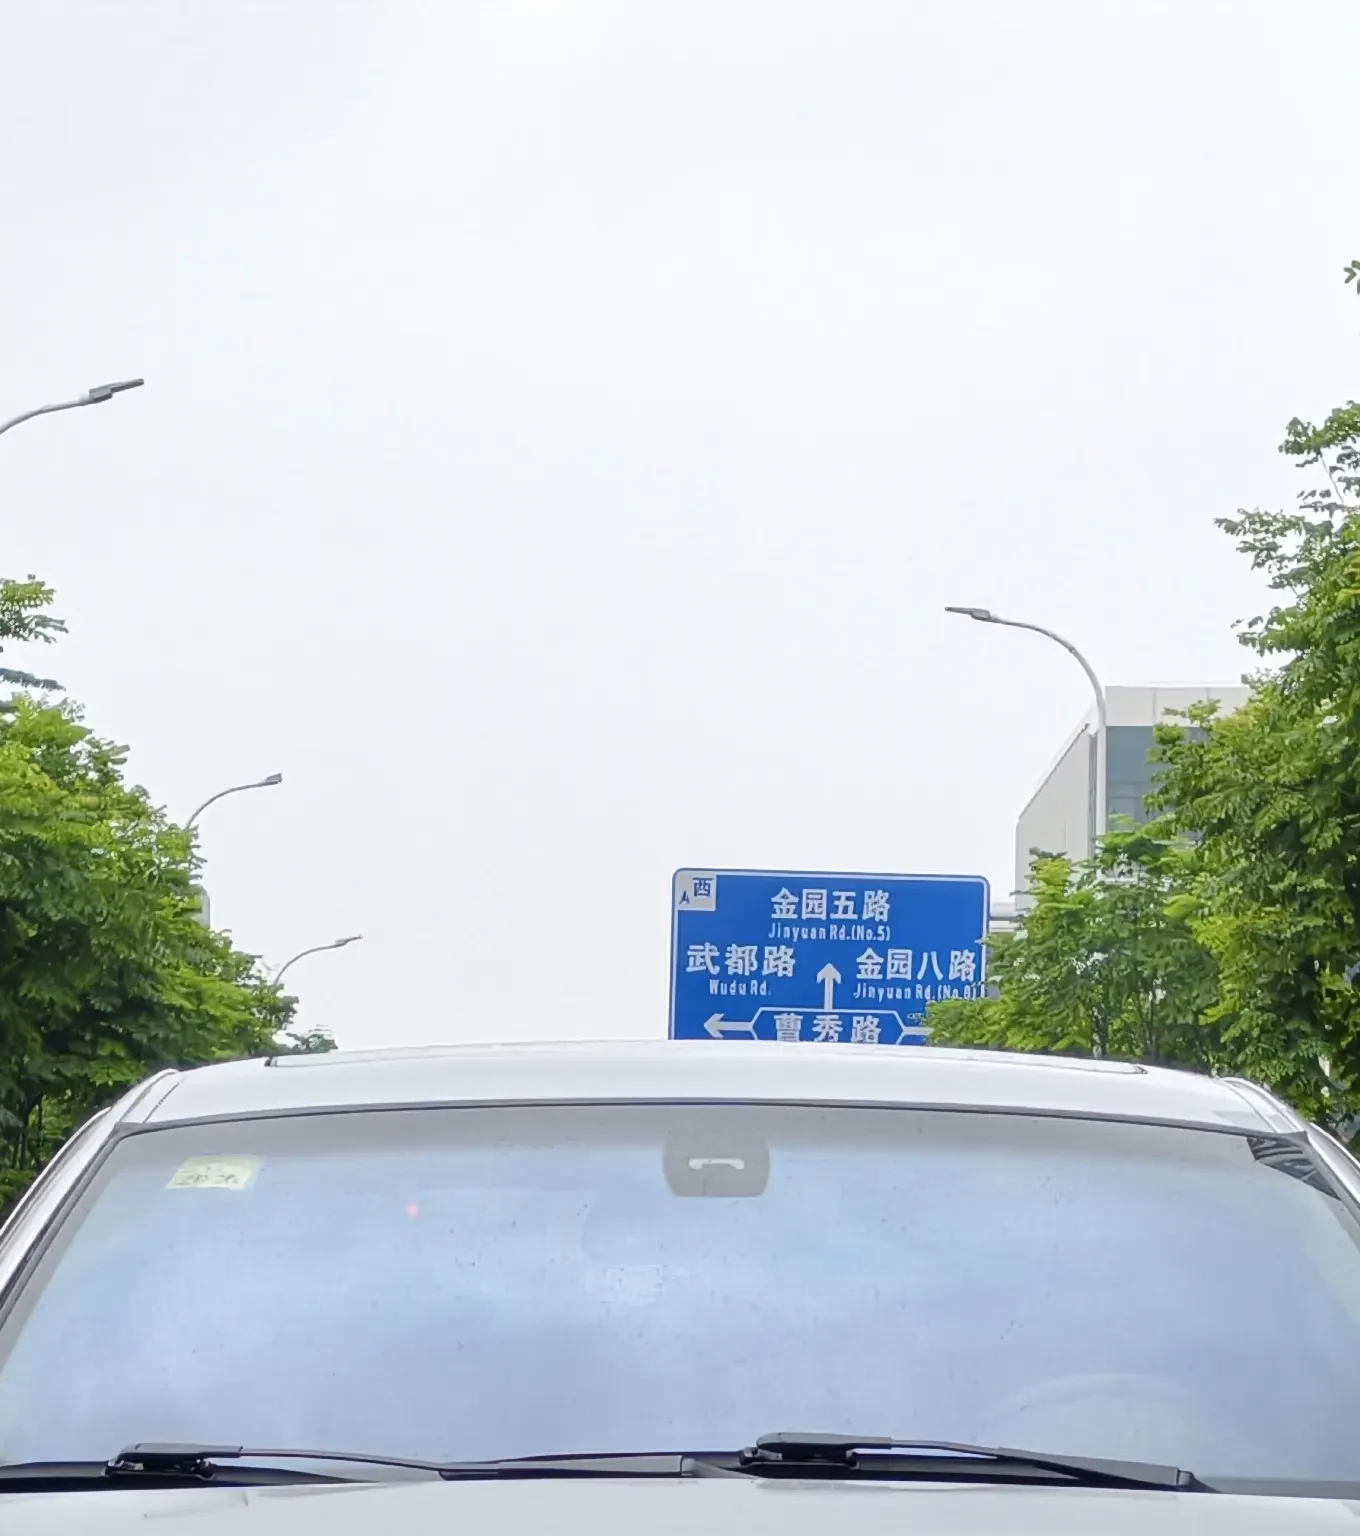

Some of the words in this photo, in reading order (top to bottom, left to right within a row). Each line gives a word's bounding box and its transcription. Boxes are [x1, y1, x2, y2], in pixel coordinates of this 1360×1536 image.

[692, 877, 714, 897] 西
[770, 887, 890, 922] 金园五路
[768, 922, 826, 942] Jinyuan
[685, 942, 796, 977] 武都路
[856, 947, 976, 981] 金园八路
[709, 979, 746, 996] Wudu
[750, 979, 772, 996] Rd.
[853, 983, 912, 1003] Jinyuan
